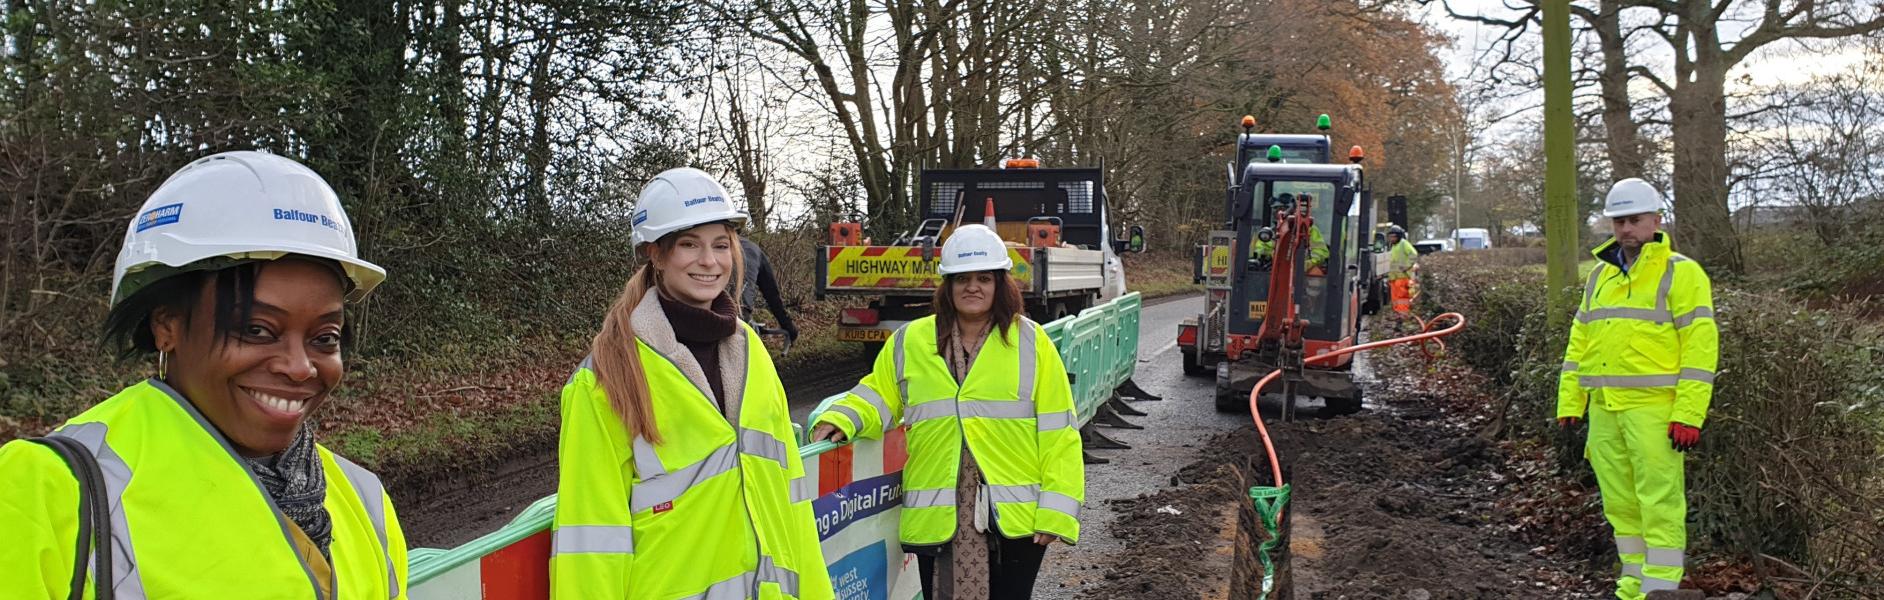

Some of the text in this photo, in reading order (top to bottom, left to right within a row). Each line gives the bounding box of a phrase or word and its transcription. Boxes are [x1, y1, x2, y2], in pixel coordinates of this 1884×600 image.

[273, 208, 319, 223] Balfour
[846, 260, 908, 274] HIGHWAY
[831, 509, 839, 526] a
[840, 488, 877, 521] Digital
[839, 567, 858, 588] west
[840, 577, 868, 600] sussex
